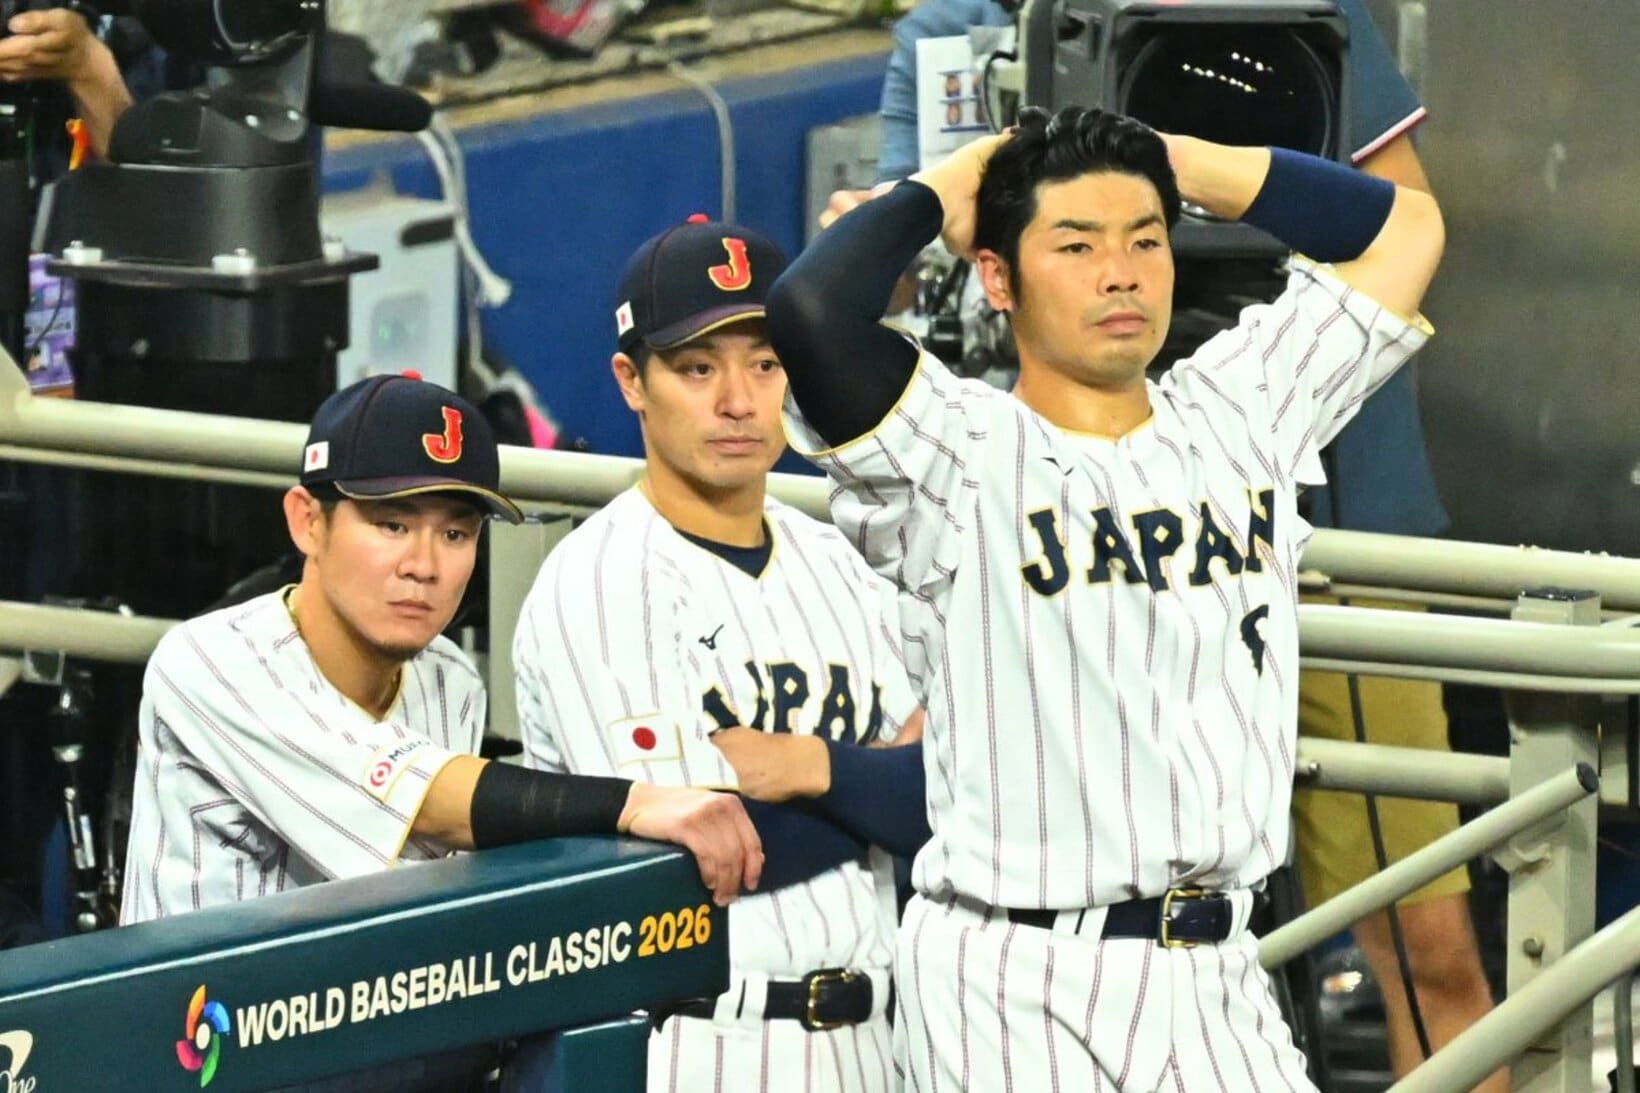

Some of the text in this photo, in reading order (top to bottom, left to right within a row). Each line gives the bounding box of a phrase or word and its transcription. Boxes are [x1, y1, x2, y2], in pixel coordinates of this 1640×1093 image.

[708, 237, 752, 292] J
[422, 406, 464, 464] J
[1021, 487, 1275, 597] JAPAN
[236, 904, 712, 1048] WORLD BASEBALL CLASSIC 2026
